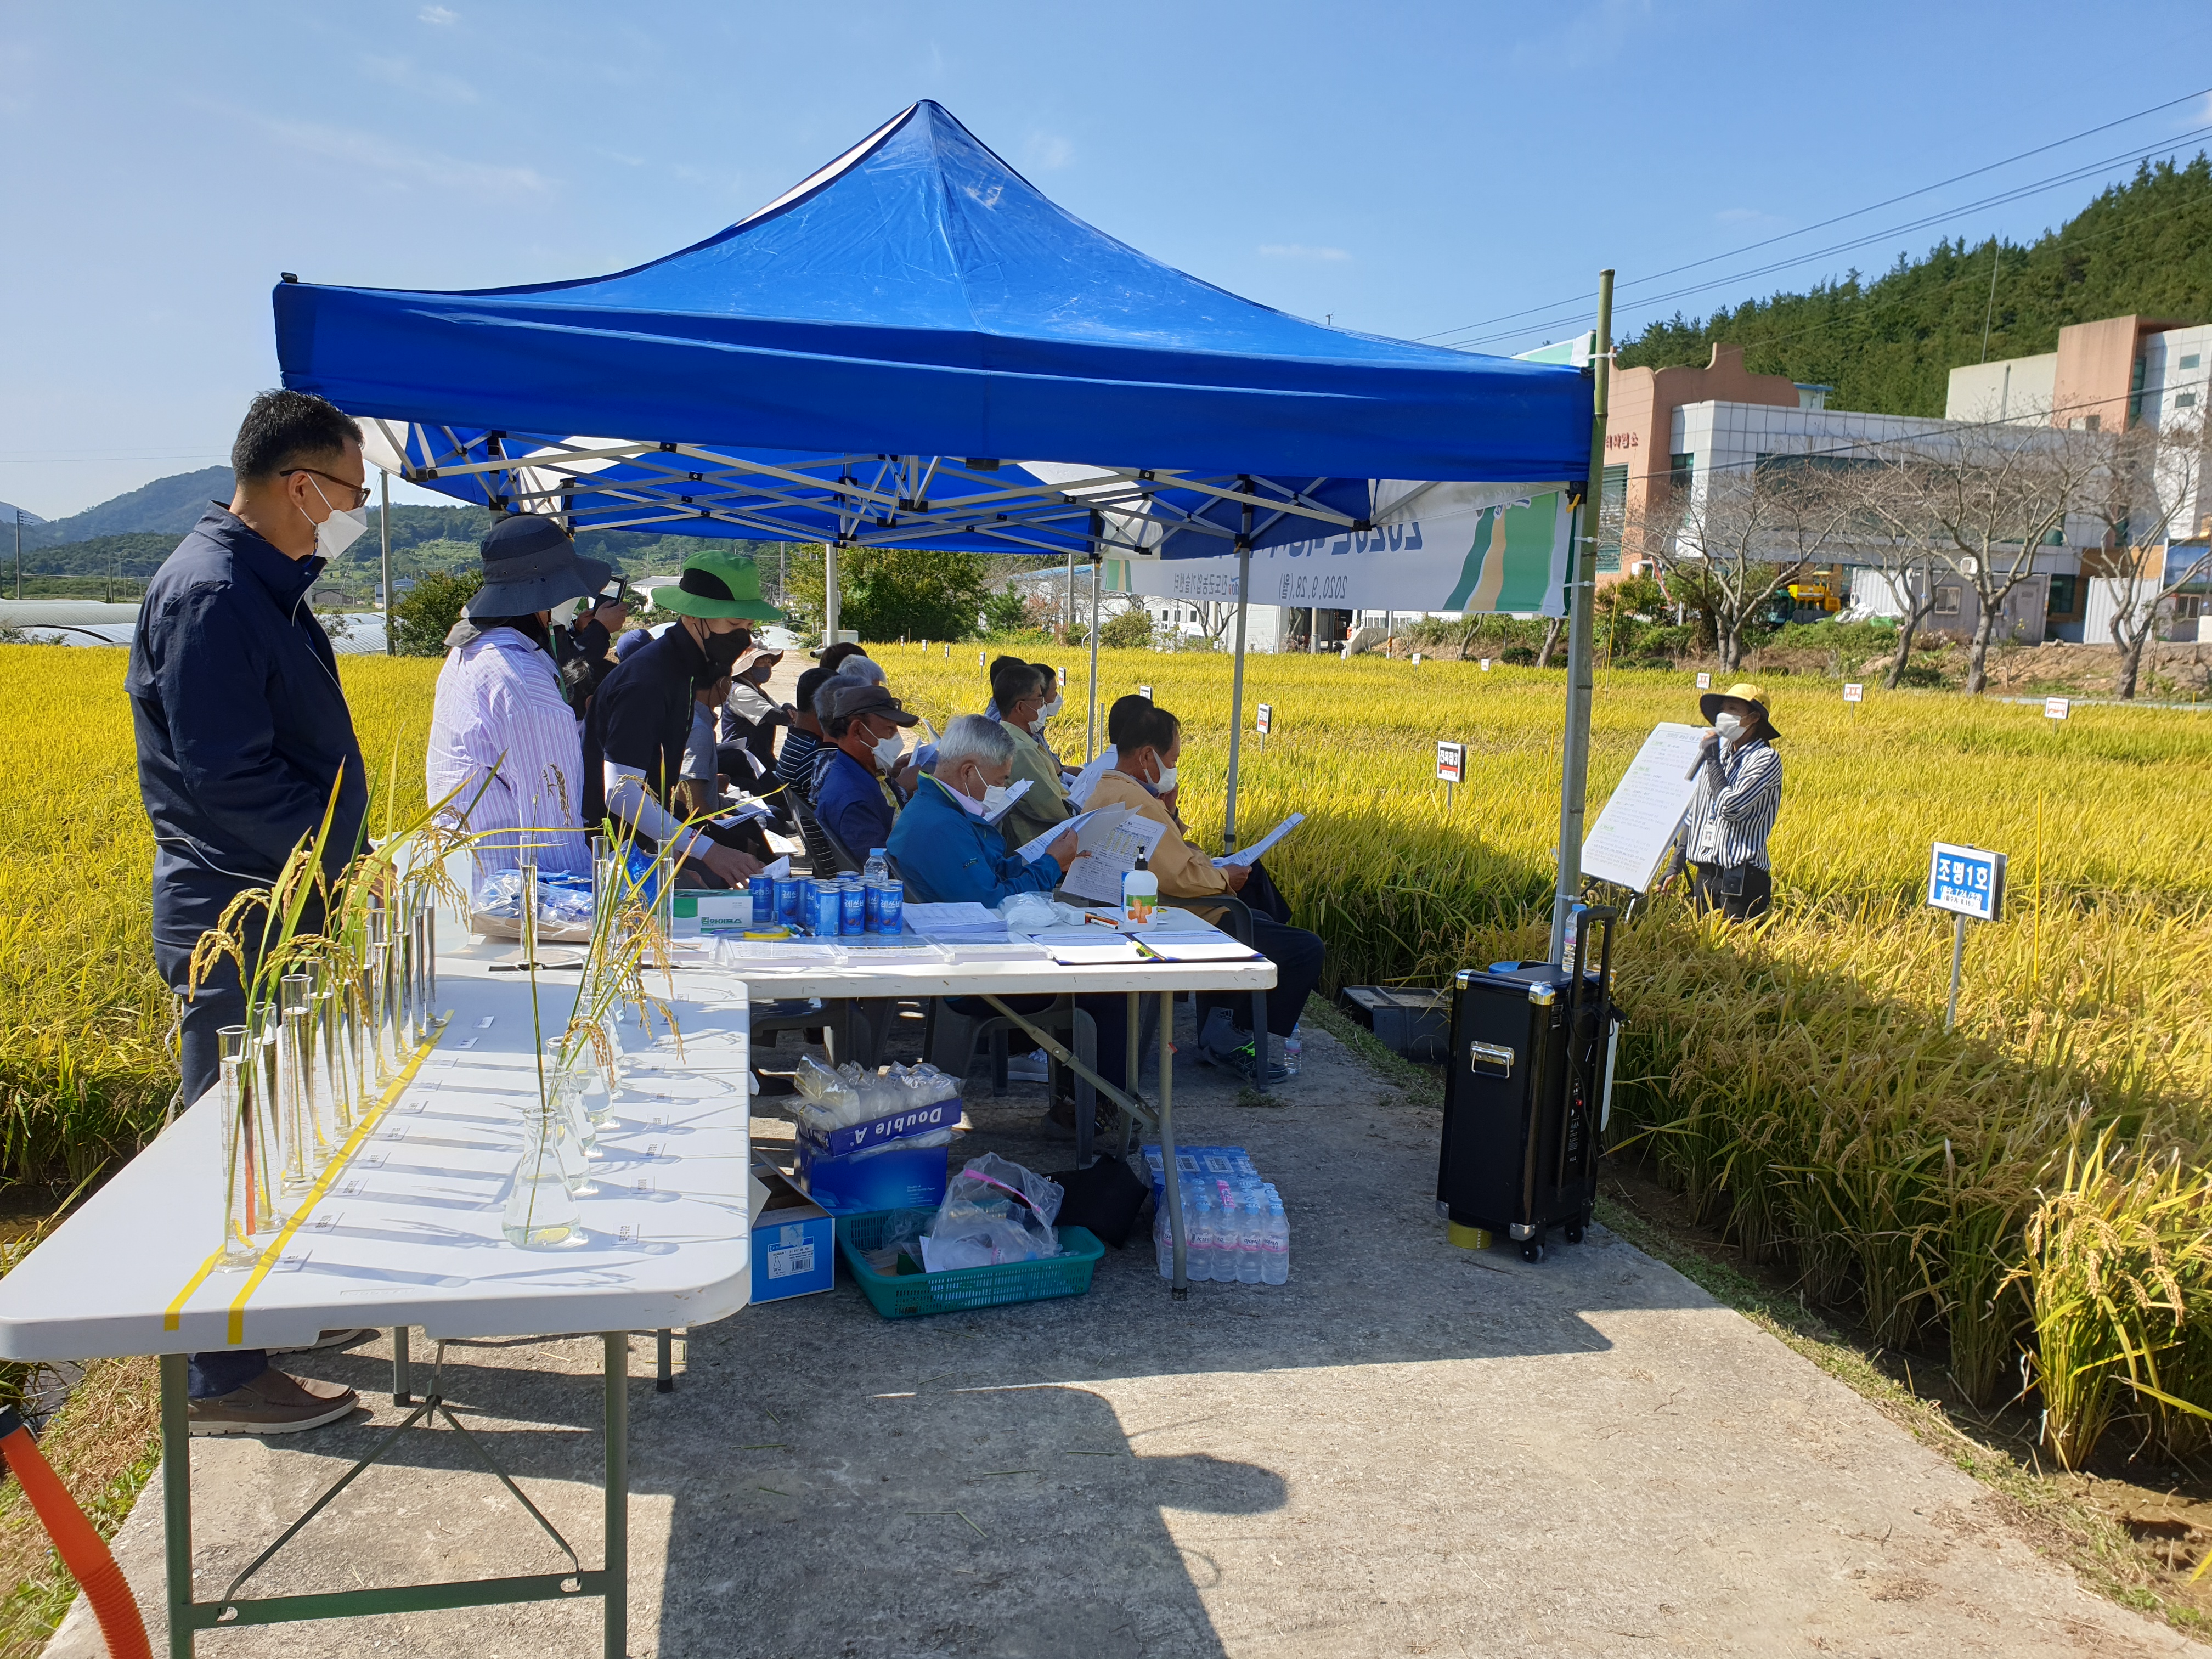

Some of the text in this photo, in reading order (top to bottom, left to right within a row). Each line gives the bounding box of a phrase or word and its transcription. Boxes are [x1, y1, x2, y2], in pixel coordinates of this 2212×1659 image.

[1937, 858, 1988, 891] 조명1호
[844, 899, 864, 908] 레쓰비
[880, 899, 901, 909] 레쓰비
[876, 1107, 943, 1136] Double
